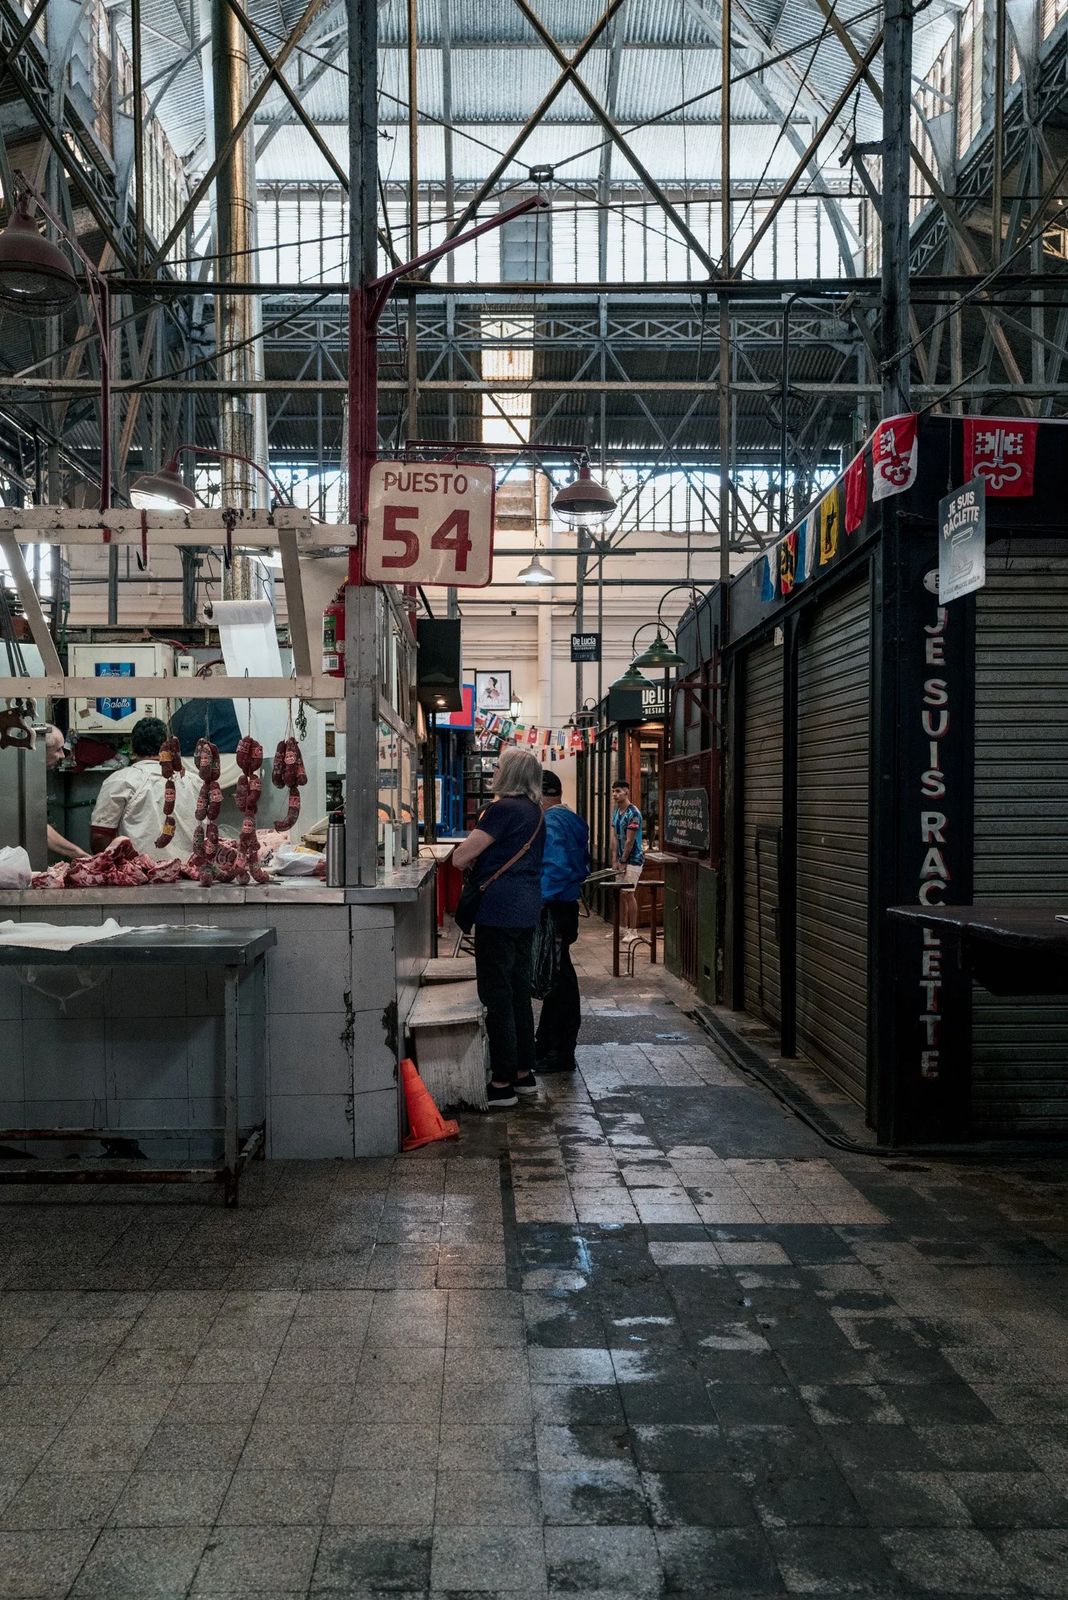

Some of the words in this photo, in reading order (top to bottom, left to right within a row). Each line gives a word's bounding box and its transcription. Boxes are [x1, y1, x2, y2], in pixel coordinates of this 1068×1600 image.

[384, 471, 468, 495] PUESTO
[948, 501, 956, 517] JE
[957, 491, 975, 508] SUIS
[381, 505, 473, 572] 54
[943, 507, 979, 539] RACLETTE
[572, 636, 581, 646] De
[923, 606, 948, 665] JE
[920, 678, 949, 799] SUIS
